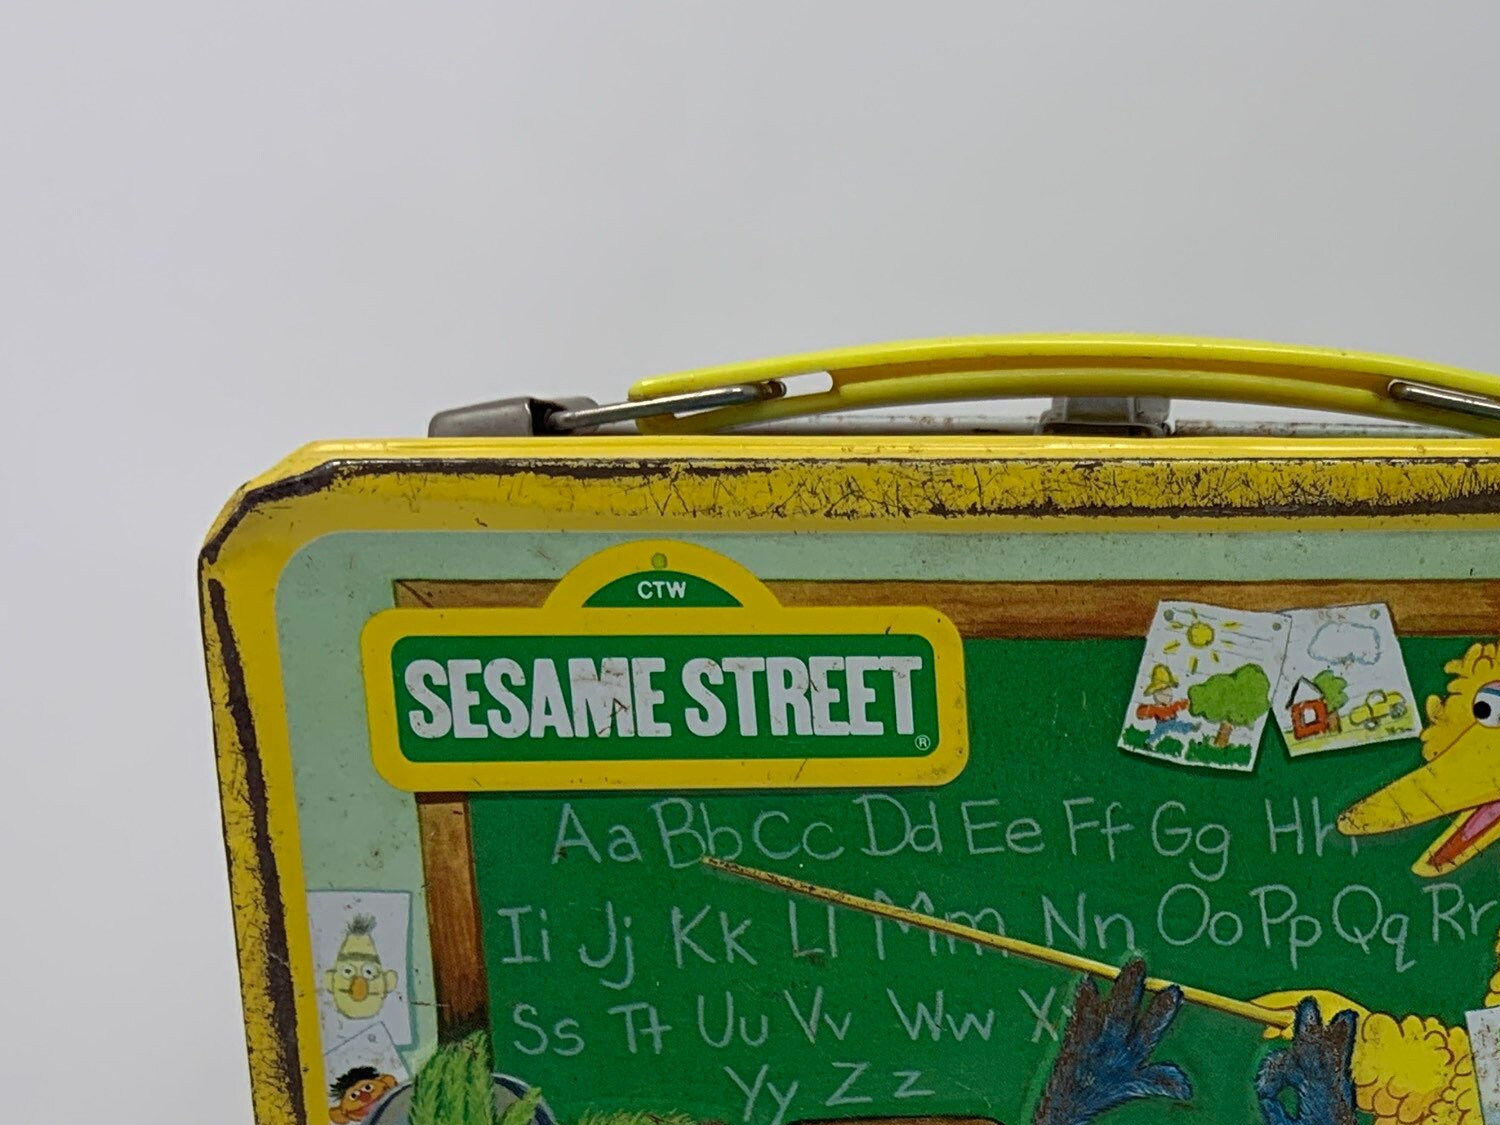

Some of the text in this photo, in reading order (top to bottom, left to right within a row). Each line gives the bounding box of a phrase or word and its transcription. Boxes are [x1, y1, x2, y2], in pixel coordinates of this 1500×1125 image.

[637, 580, 686, 600] CTW
[404, 657, 671, 739] SESAME
[681, 655, 923, 737] STREET
[551, 803, 642, 864] Aa
[650, 797, 744, 869] Bb
[751, 810, 846, 861] Cc
[853, 793, 943, 856] Dd
[960, 799, 1045, 856] Ee
[1062, 797, 1133, 862] Ff
[1151, 800, 1233, 882] Gg
[578, 900, 636, 991] Jj
[671, 904, 759, 969] Kk
[1042, 891, 1136, 951] Nn
[1156, 883, 1244, 950] Oo
[1249, 884, 1322, 970] Pp
[1331, 884, 1417, 973] Qq
[1421, 882, 1499, 943] Rr
[511, 1002, 586, 1057] Ss
[697, 990, 770, 1049] Uu
[783, 986, 852, 1045] Vv
[885, 987, 996, 1044] Ww
[1018, 986, 1074, 1043] X
